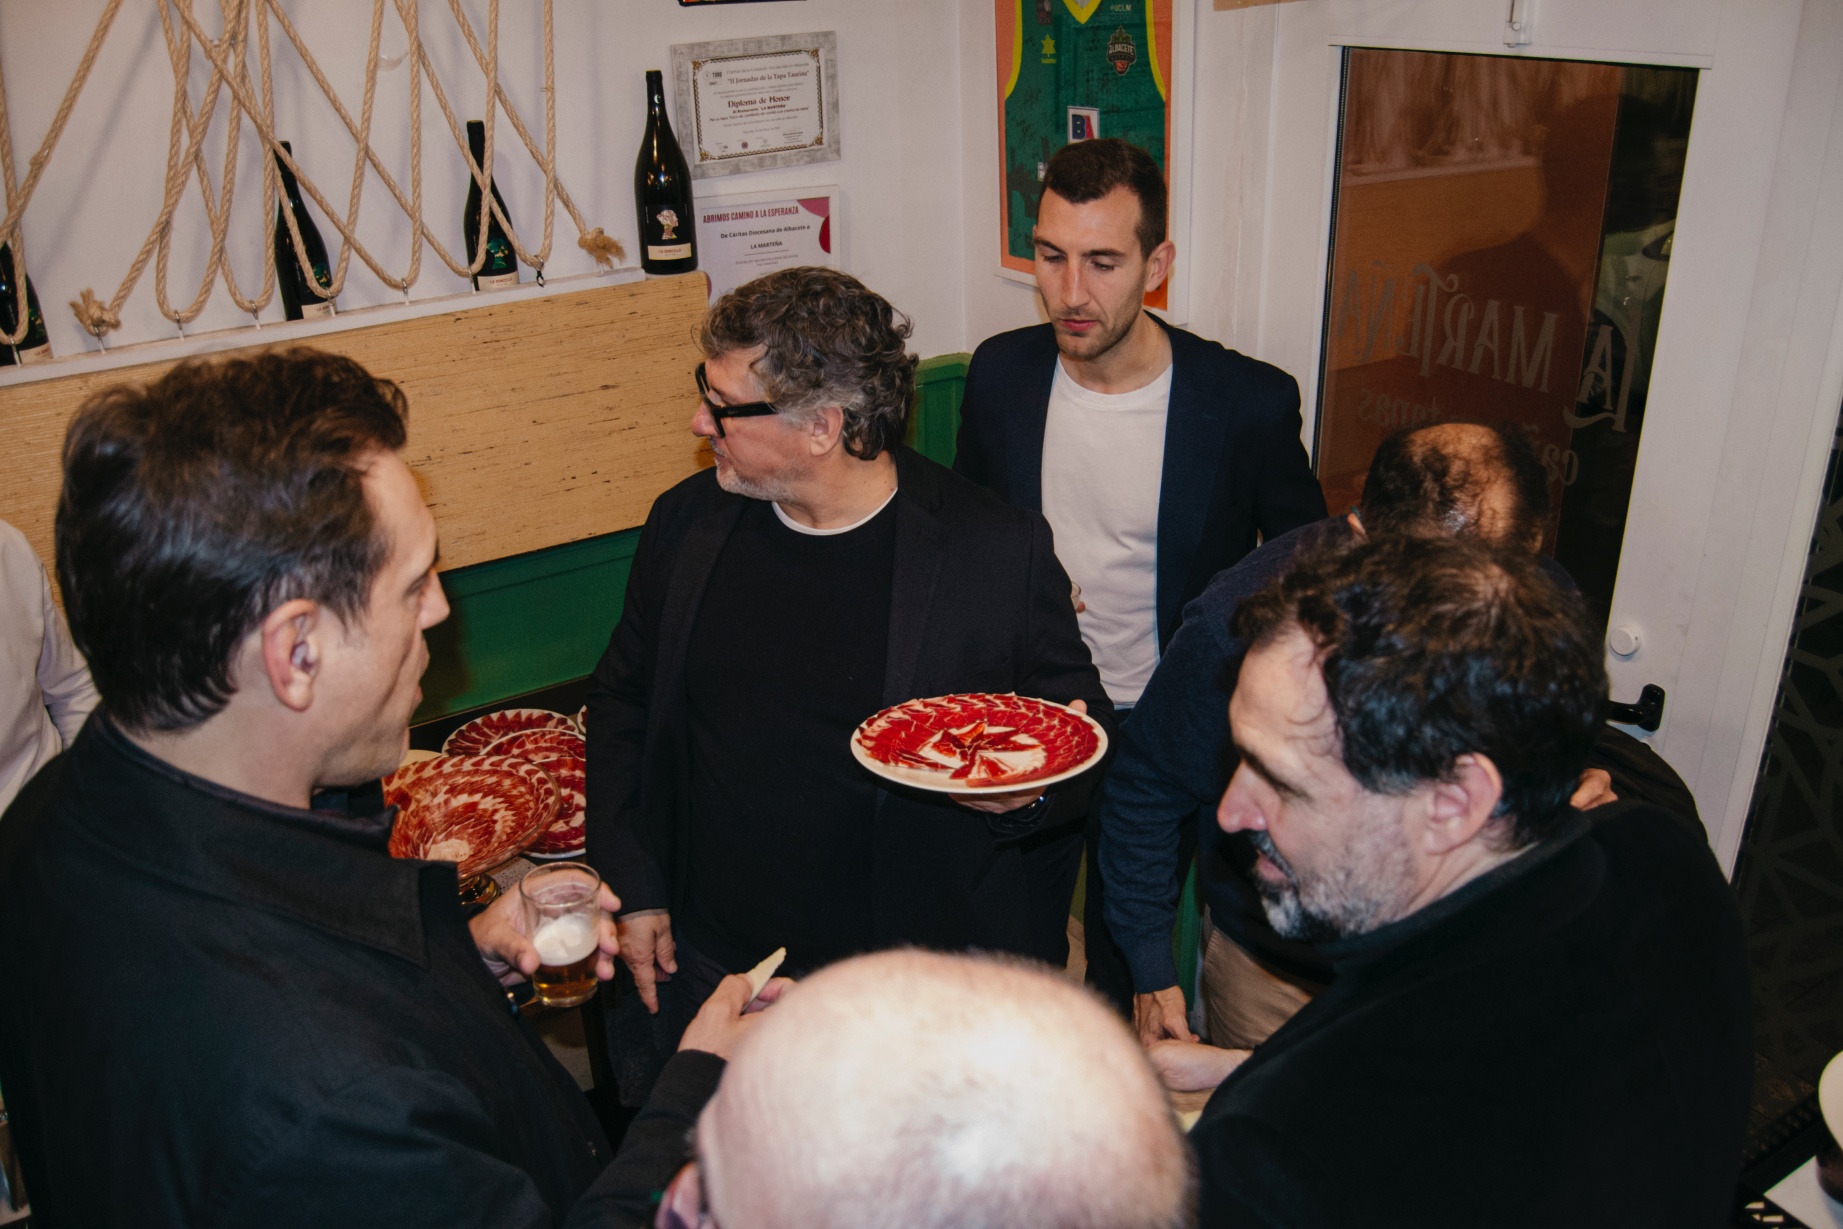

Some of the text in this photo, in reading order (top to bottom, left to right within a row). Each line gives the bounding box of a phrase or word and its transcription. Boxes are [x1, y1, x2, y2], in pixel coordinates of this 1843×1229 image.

[735, 76, 759, 84] Jornadas
[773, 72, 786, 80] Tapa
[728, 99, 757, 109] Diploma
[769, 94, 791, 103] Honor
[703, 214, 730, 224] ABRIMOS
[731, 212, 754, 221] CAMINO
[760, 210, 767, 218] LA
[768, 206, 799, 217] ESPERANZA
[729, 230, 748, 238] Cáritas
[748, 228, 775, 236] Diocesana
[783, 224, 806, 232] Albacete
[758, 240, 783, 249] MARTEÑA
